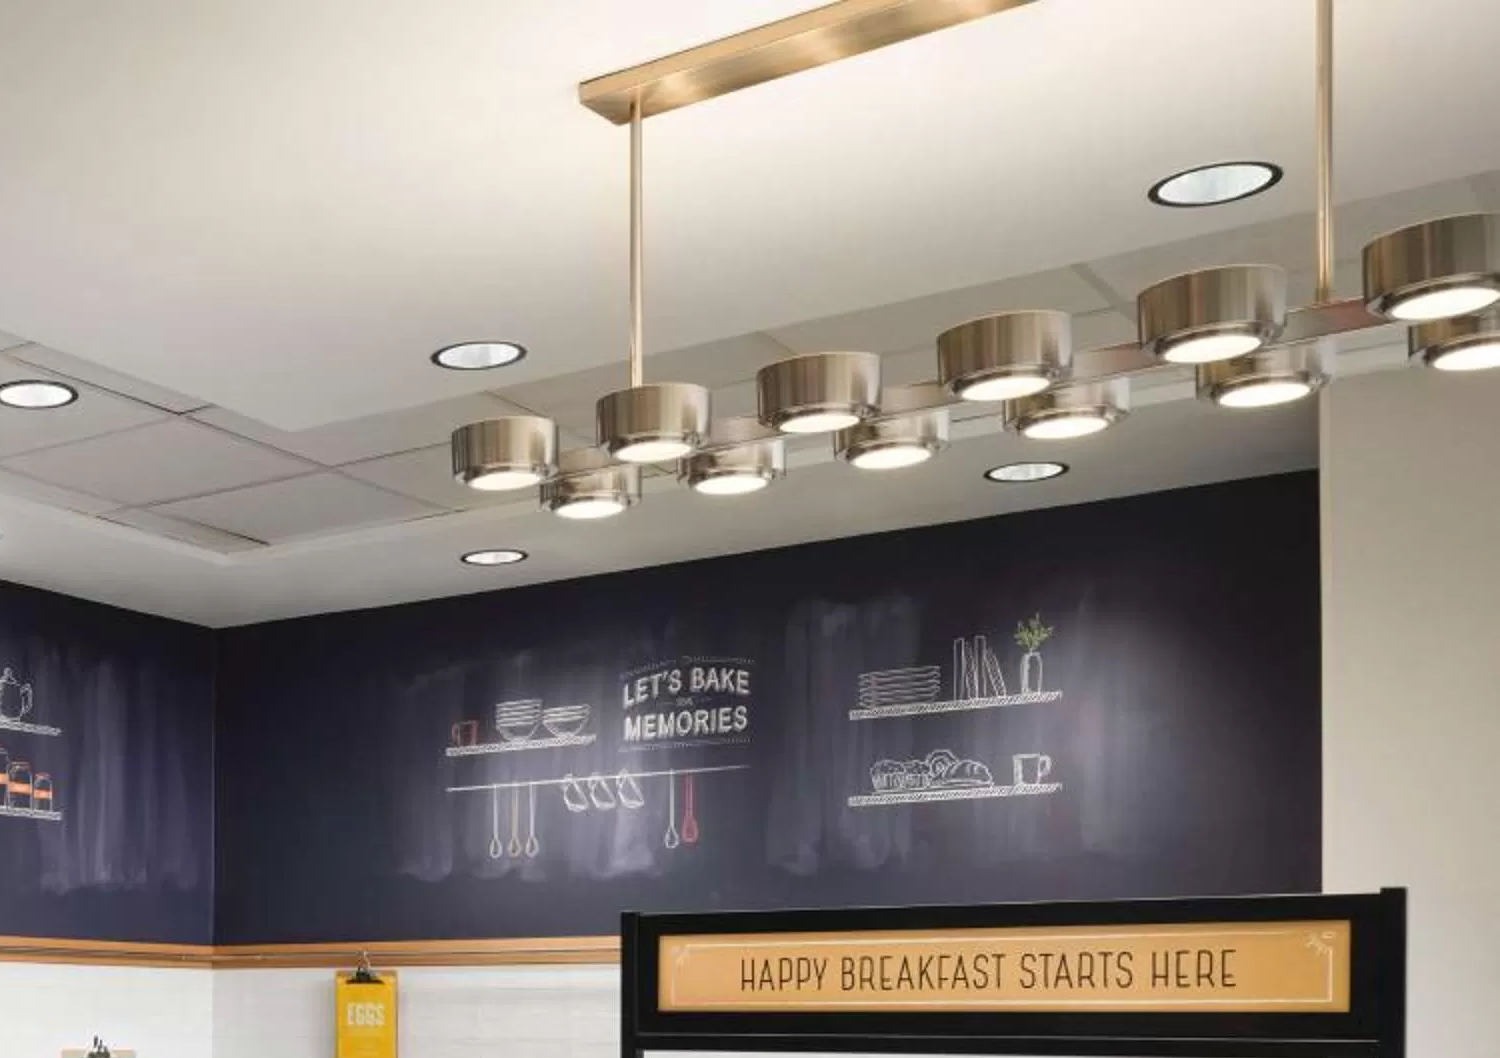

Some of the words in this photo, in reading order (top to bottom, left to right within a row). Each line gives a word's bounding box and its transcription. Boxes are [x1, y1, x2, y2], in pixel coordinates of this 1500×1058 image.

[622, 668, 682, 709] LET'S
[689, 666, 750, 695] BAKE
[623, 705, 748, 741] MEMORIES
[740, 956, 828, 991] HAPPY
[841, 953, 1007, 991] BREAKFAST
[1019, 951, 1134, 989] STARTS
[1151, 948, 1238, 988] HERE
[346, 1003, 386, 1026] EGGS
